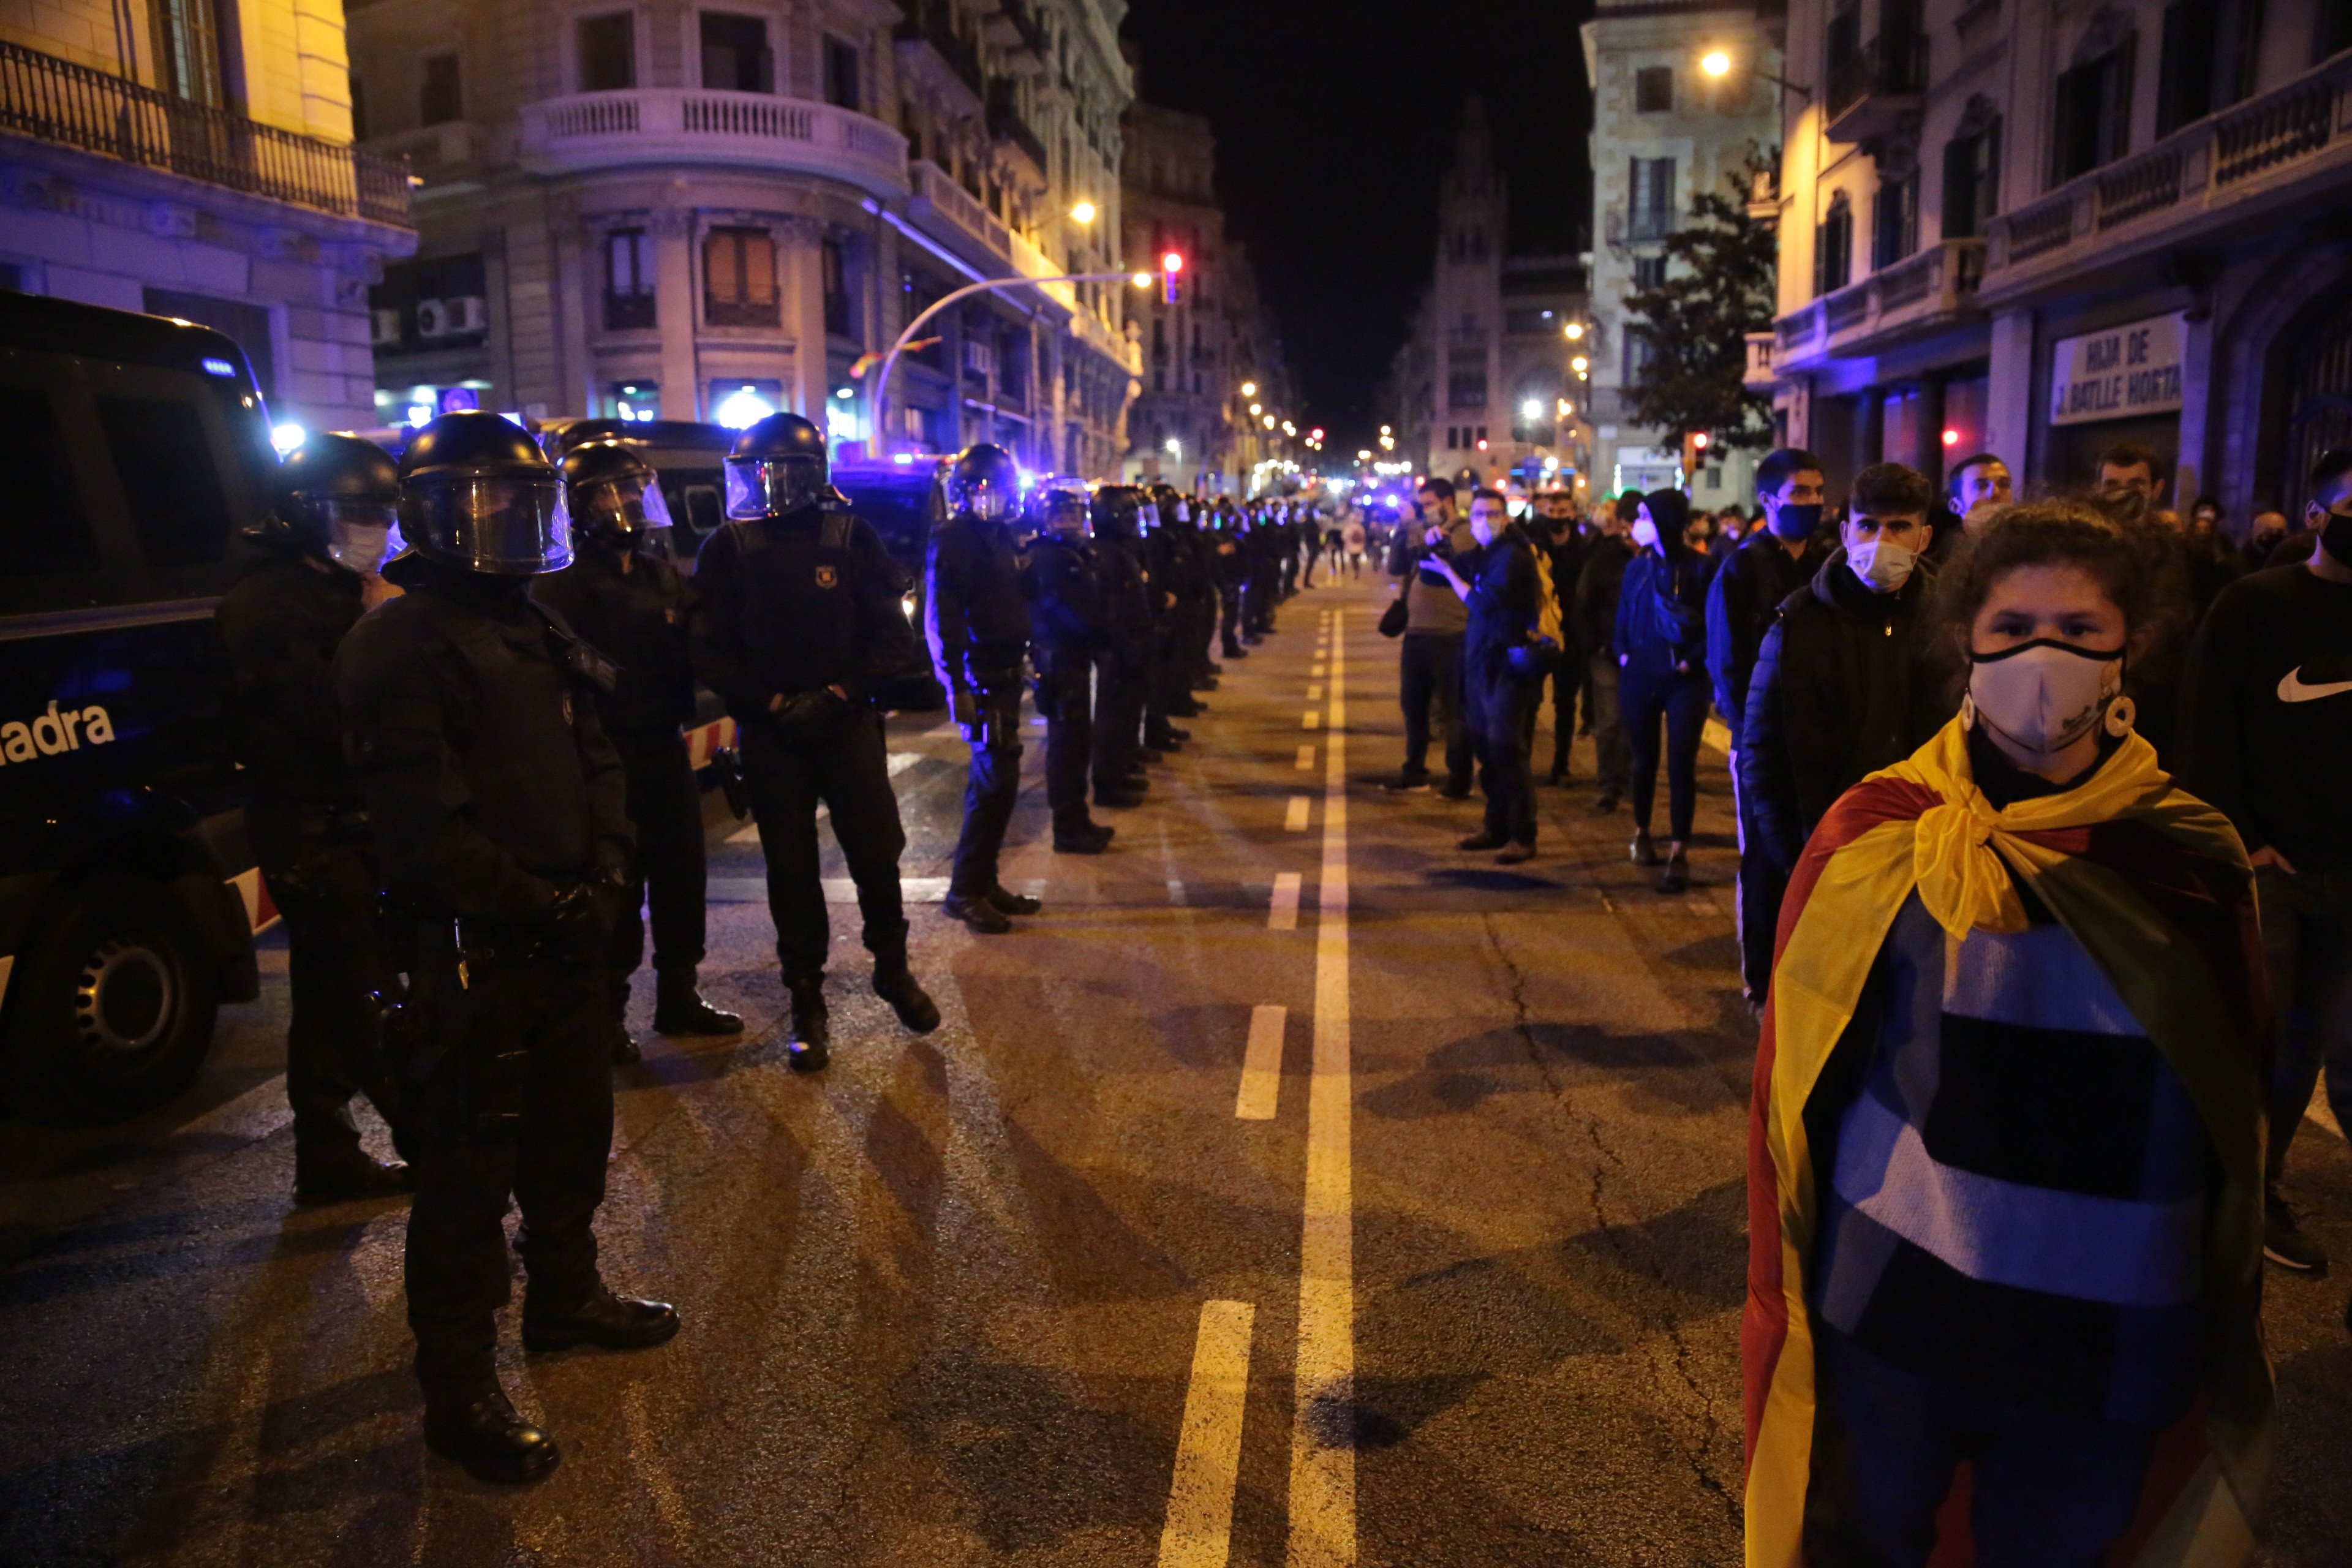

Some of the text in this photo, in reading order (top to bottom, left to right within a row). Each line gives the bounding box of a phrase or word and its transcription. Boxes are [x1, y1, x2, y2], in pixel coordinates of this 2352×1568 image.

[2086, 328, 2150, 372] HIJA DE
[2070, 375, 2122, 413] BATLLE
[2128, 364, 2182, 405] HORTA
[0, 699, 116, 766] adra
